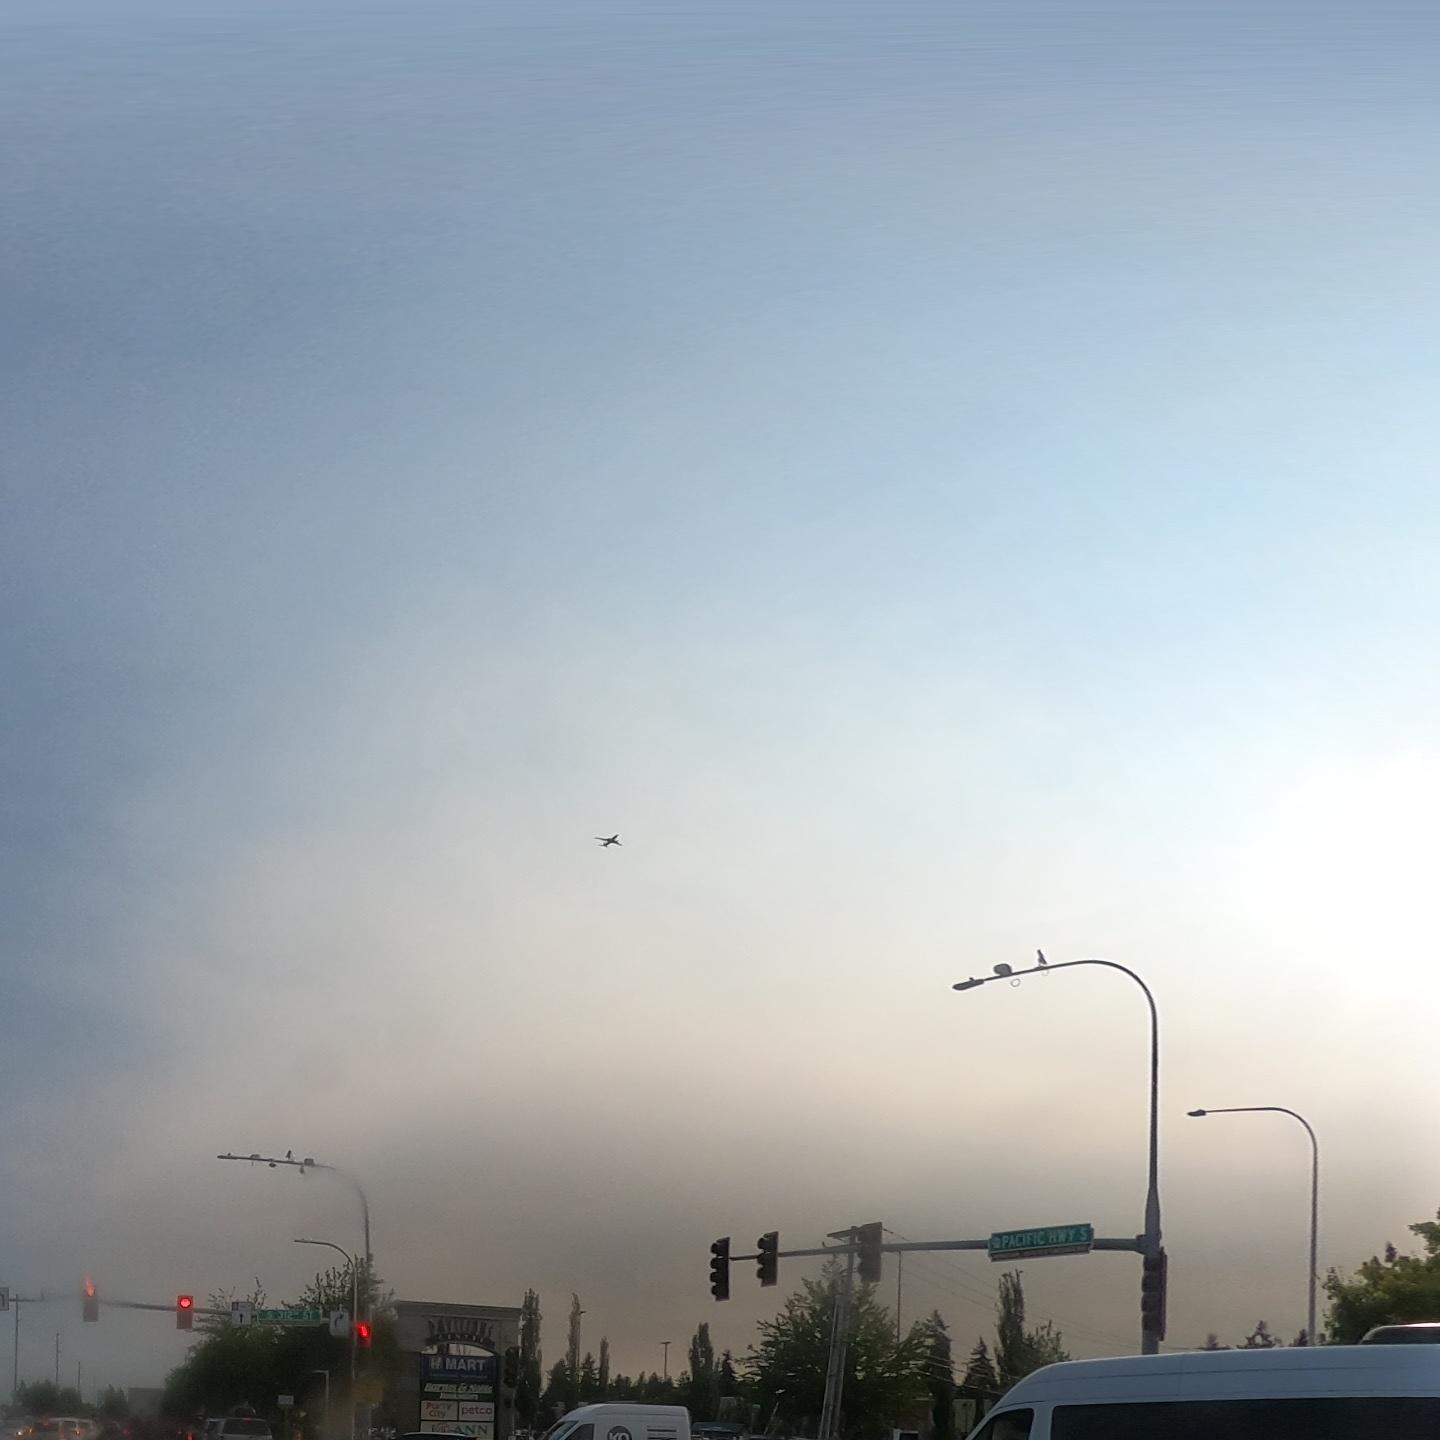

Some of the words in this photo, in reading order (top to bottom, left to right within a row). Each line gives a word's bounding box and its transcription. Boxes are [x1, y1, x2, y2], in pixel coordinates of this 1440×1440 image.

[1002, 1231, 1045, 1249] PACIFIC
[1048, 1229, 1074, 1245] HWY
[1080, 1227, 1089, 1242] S
[446, 1358, 486, 1371] MART
[462, 1406, 493, 1417] petco
